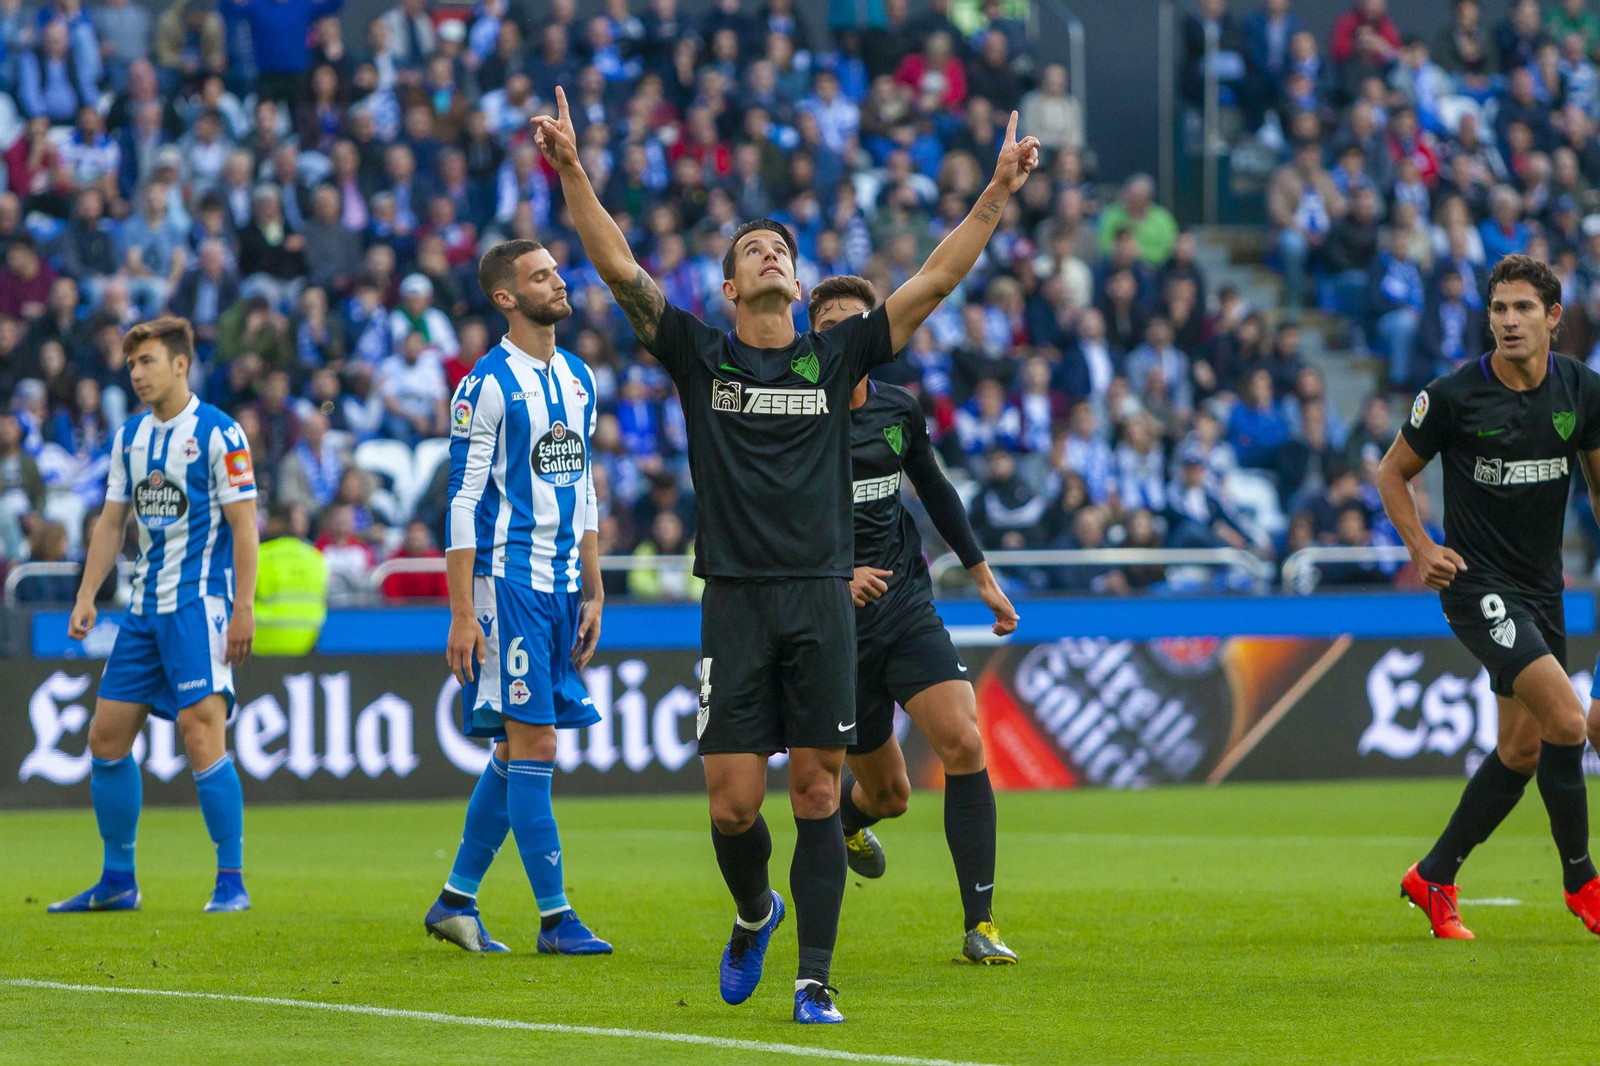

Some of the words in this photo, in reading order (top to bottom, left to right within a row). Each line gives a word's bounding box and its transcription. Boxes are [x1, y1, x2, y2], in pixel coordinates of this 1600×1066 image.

[742, 387, 830, 415] TESESA
[538, 439, 582, 458] Estrella
[540, 454, 582, 474] Galicia
[1502, 456, 1569, 485] TESESA
[137, 486, 180, 502] Estrella
[139, 500, 178, 516] Galicia
[1480, 593, 1506, 626] 9
[506, 636, 529, 677] 6
